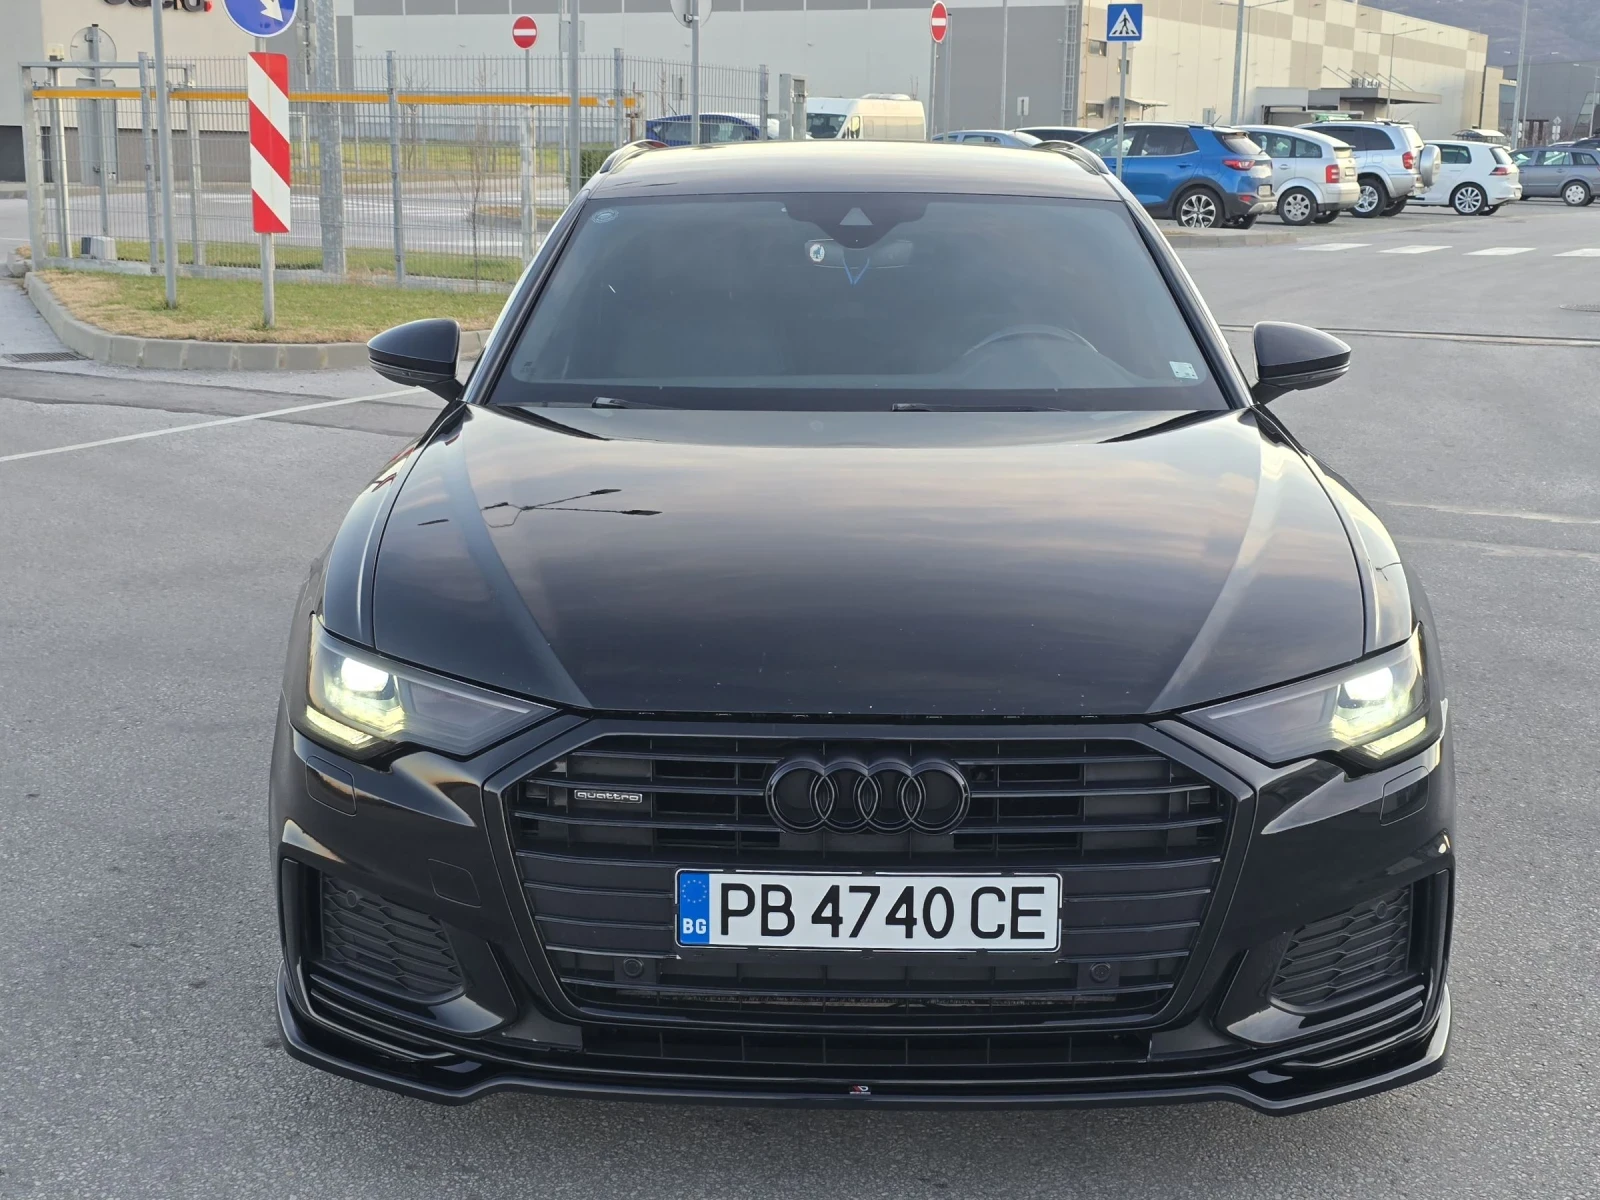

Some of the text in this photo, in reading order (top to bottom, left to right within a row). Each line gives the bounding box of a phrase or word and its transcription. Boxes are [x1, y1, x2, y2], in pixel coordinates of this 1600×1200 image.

[577, 792, 639, 801] quattro
[721, 883, 1045, 940] PB 4740 CE
[683, 918, 707, 935] BG
